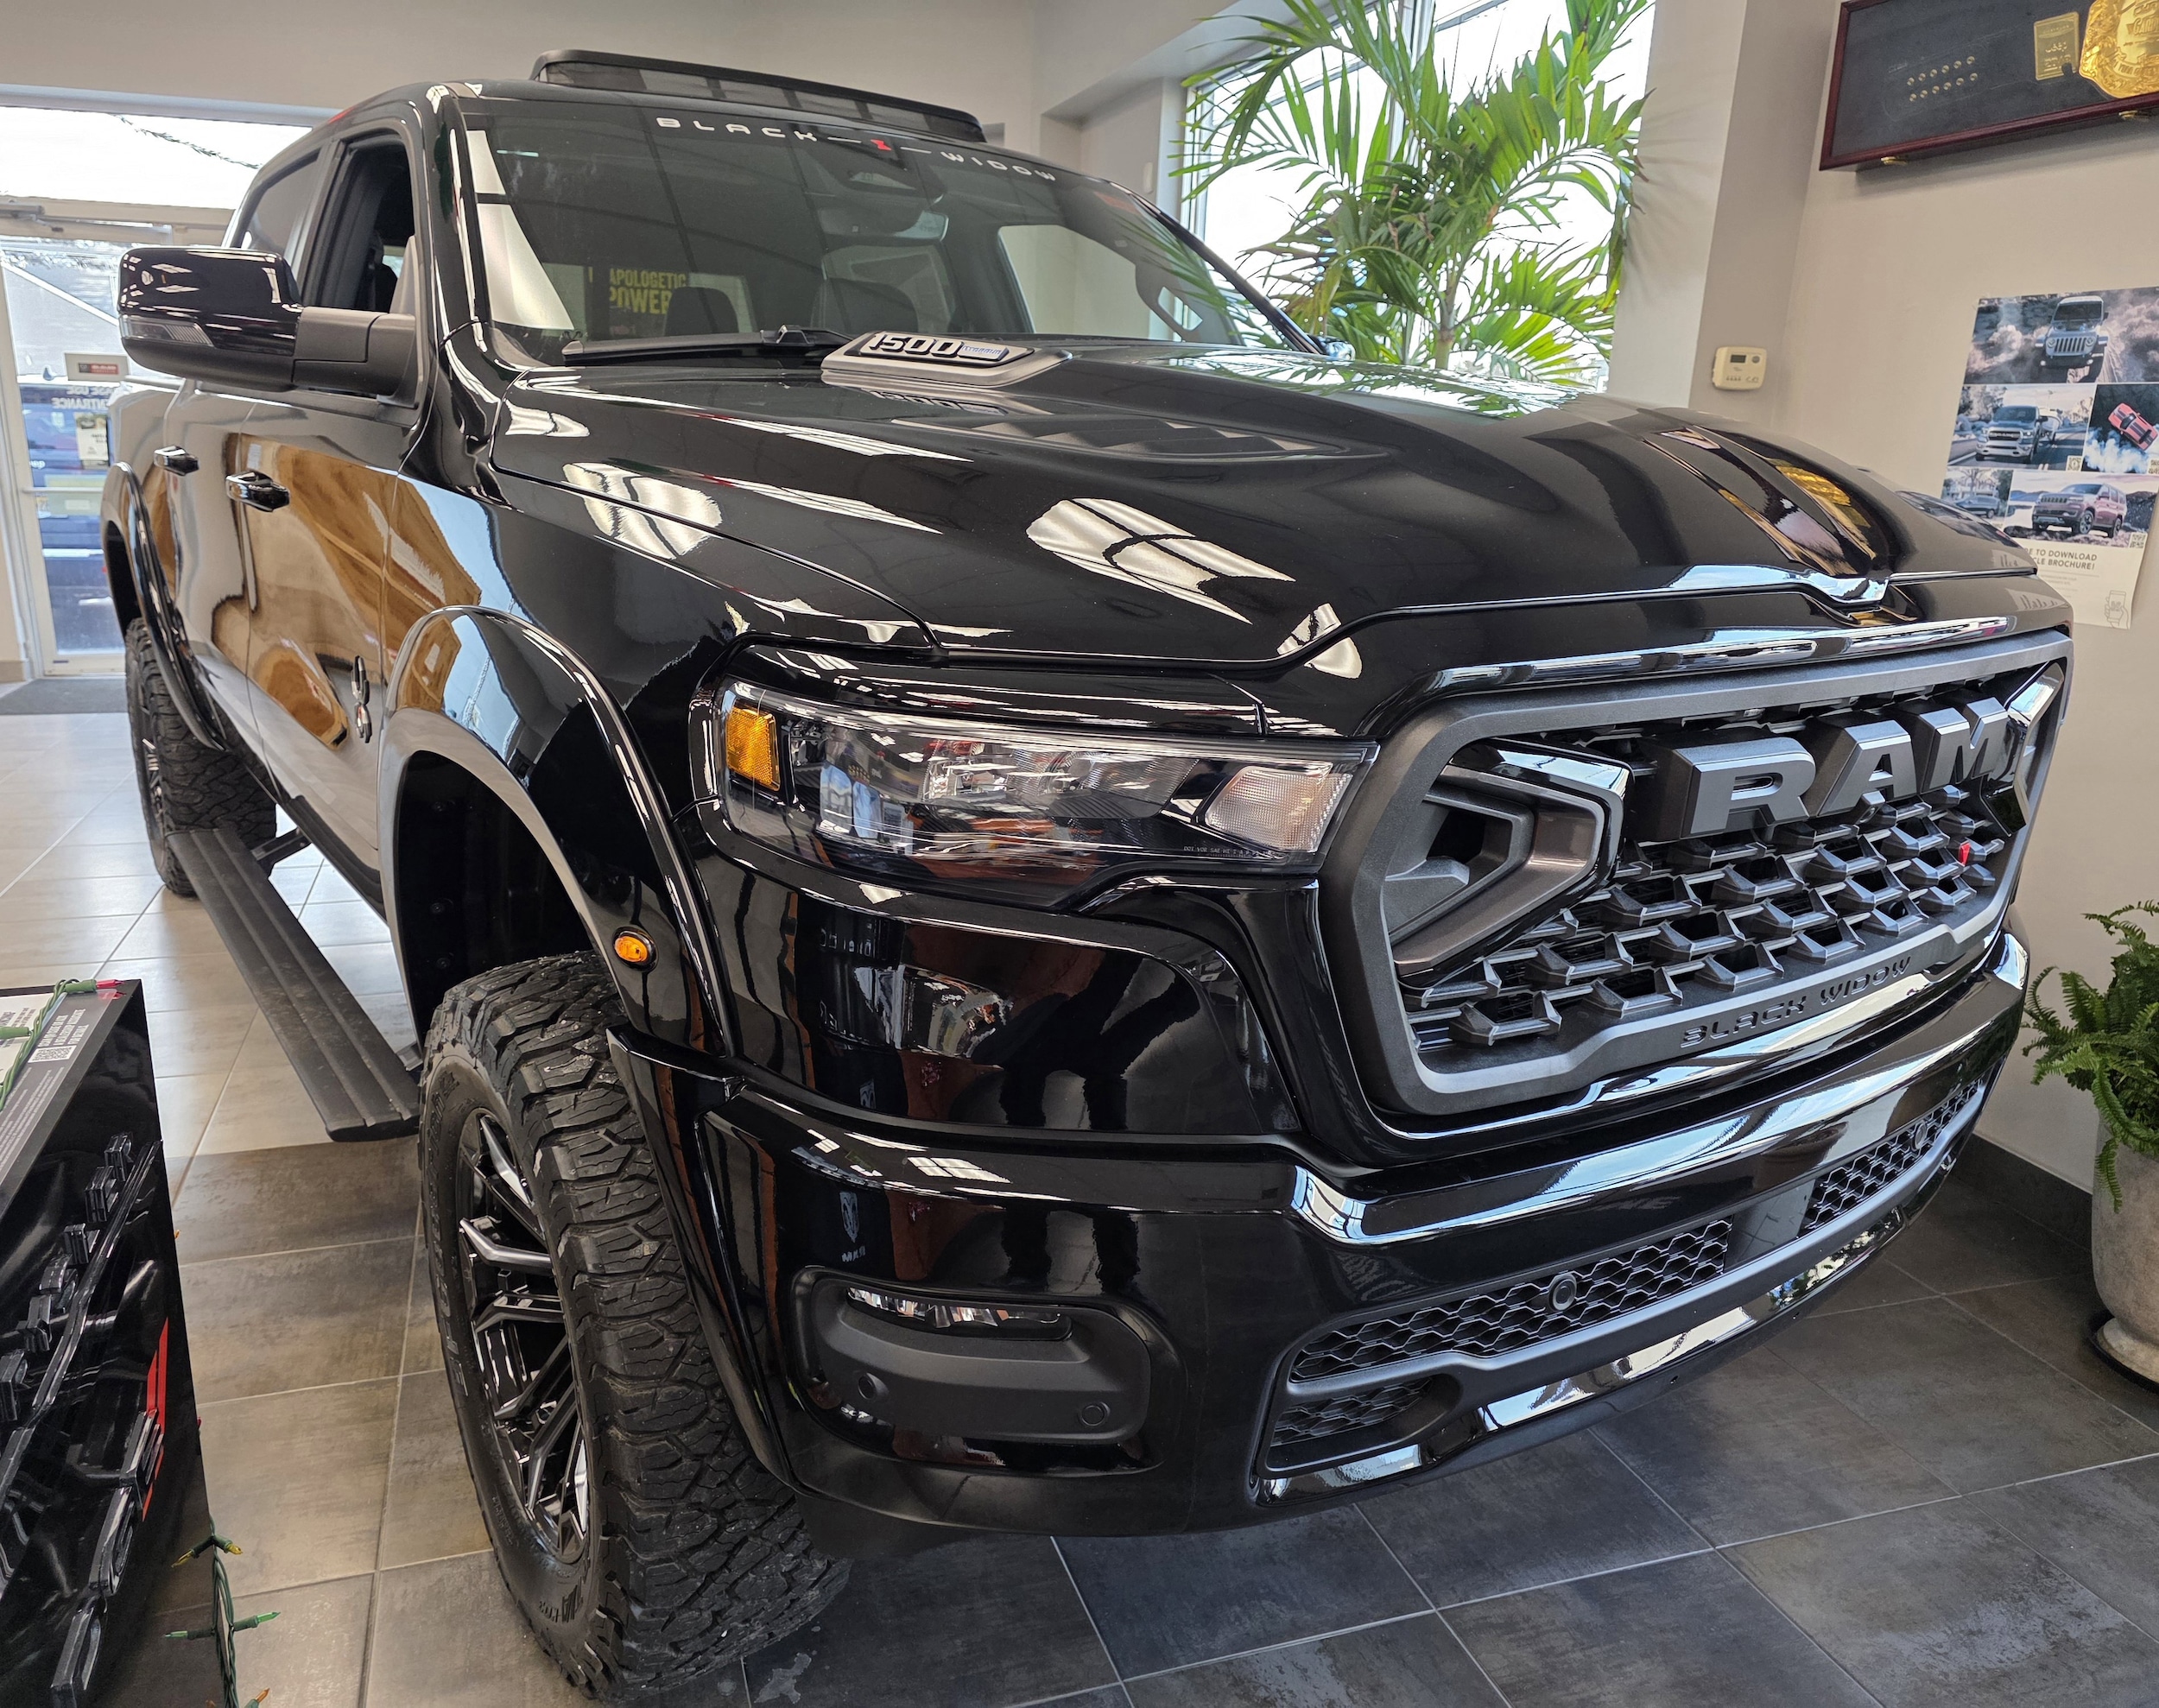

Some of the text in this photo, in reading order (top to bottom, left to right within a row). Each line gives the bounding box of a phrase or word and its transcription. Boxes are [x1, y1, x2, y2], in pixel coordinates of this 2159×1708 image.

[655, 117, 1056, 181] BLACK WIDOW
[866, 333, 964, 357] 1500
[2048, 549, 2098, 561] DOWNLOAD
[2048, 559, 2095, 570] BROCHURE!
[1684, 697, 2010, 837] RAM
[1680, 955, 1911, 1048] BLACK WIDOW
